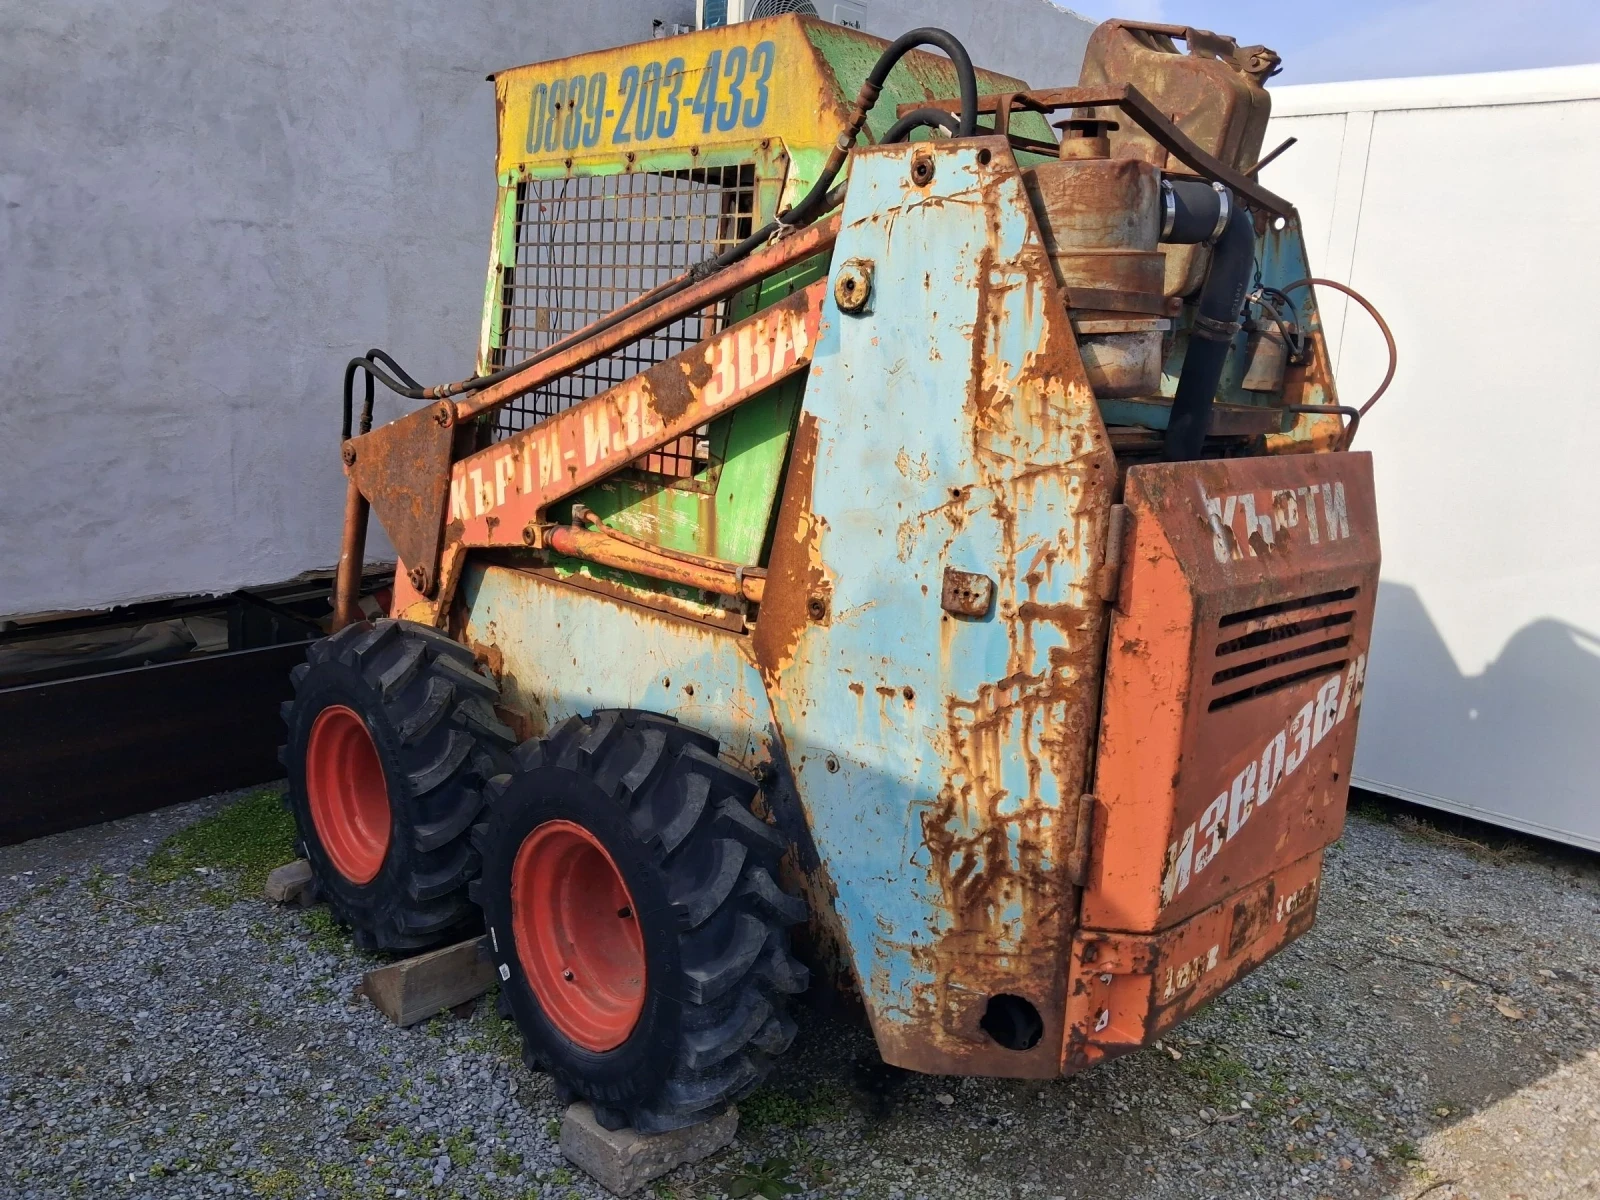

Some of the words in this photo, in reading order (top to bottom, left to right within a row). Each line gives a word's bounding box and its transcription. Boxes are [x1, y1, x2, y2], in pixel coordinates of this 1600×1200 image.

[526, 41, 776, 154] 0889-203-433
[1197, 478, 1350, 564] КЪРТИ
[1158, 653, 1366, 913] ИЗВОЗВА
